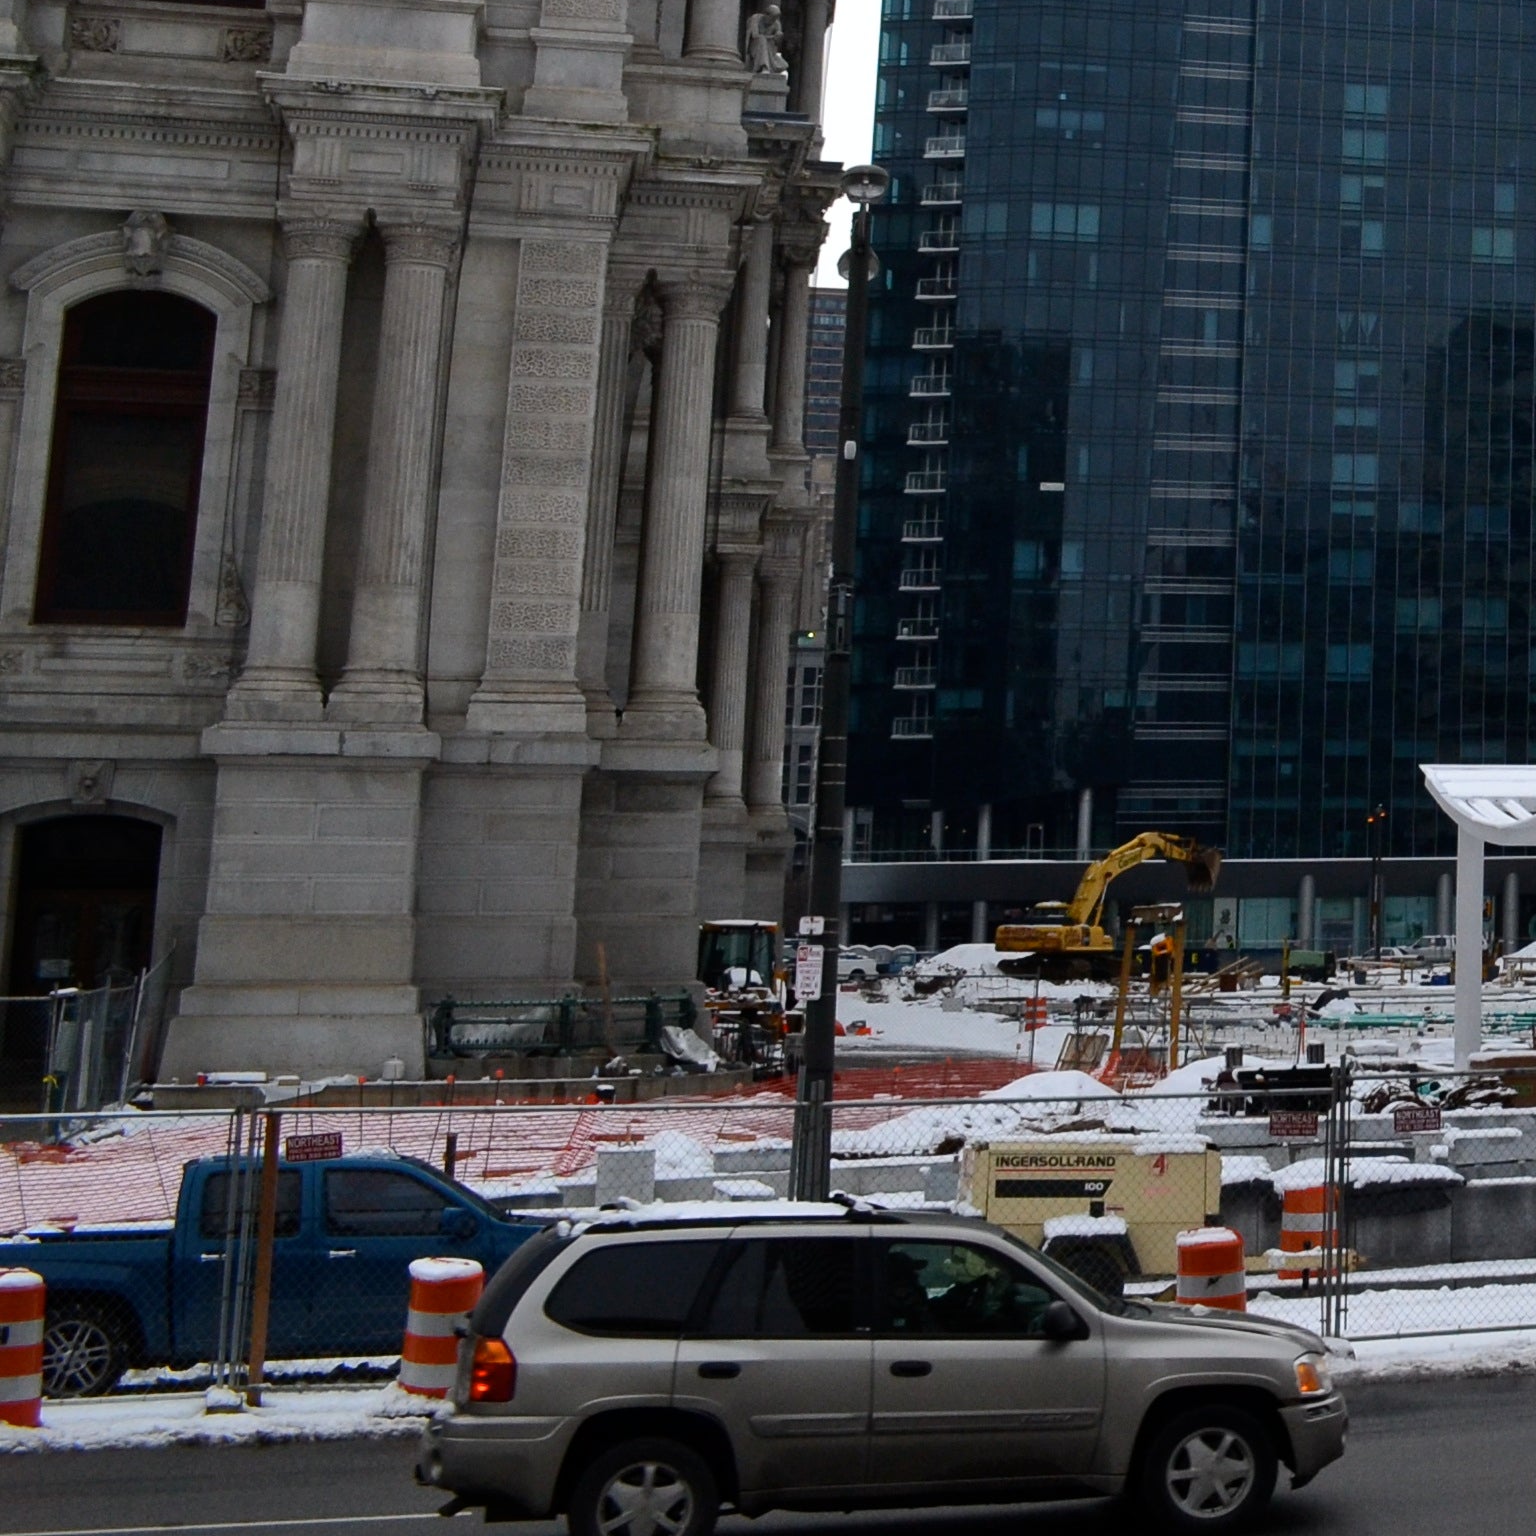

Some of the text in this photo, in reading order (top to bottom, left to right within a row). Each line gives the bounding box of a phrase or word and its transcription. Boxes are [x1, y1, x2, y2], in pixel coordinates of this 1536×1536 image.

[1271, 1113, 1318, 1124] NORTHEAST
[1395, 1109, 1440, 1120] NORTHEAST
[287, 1134, 341, 1149] NORTHEAST
[995, 1155, 1117, 1168] INGERSOLL-RAND
